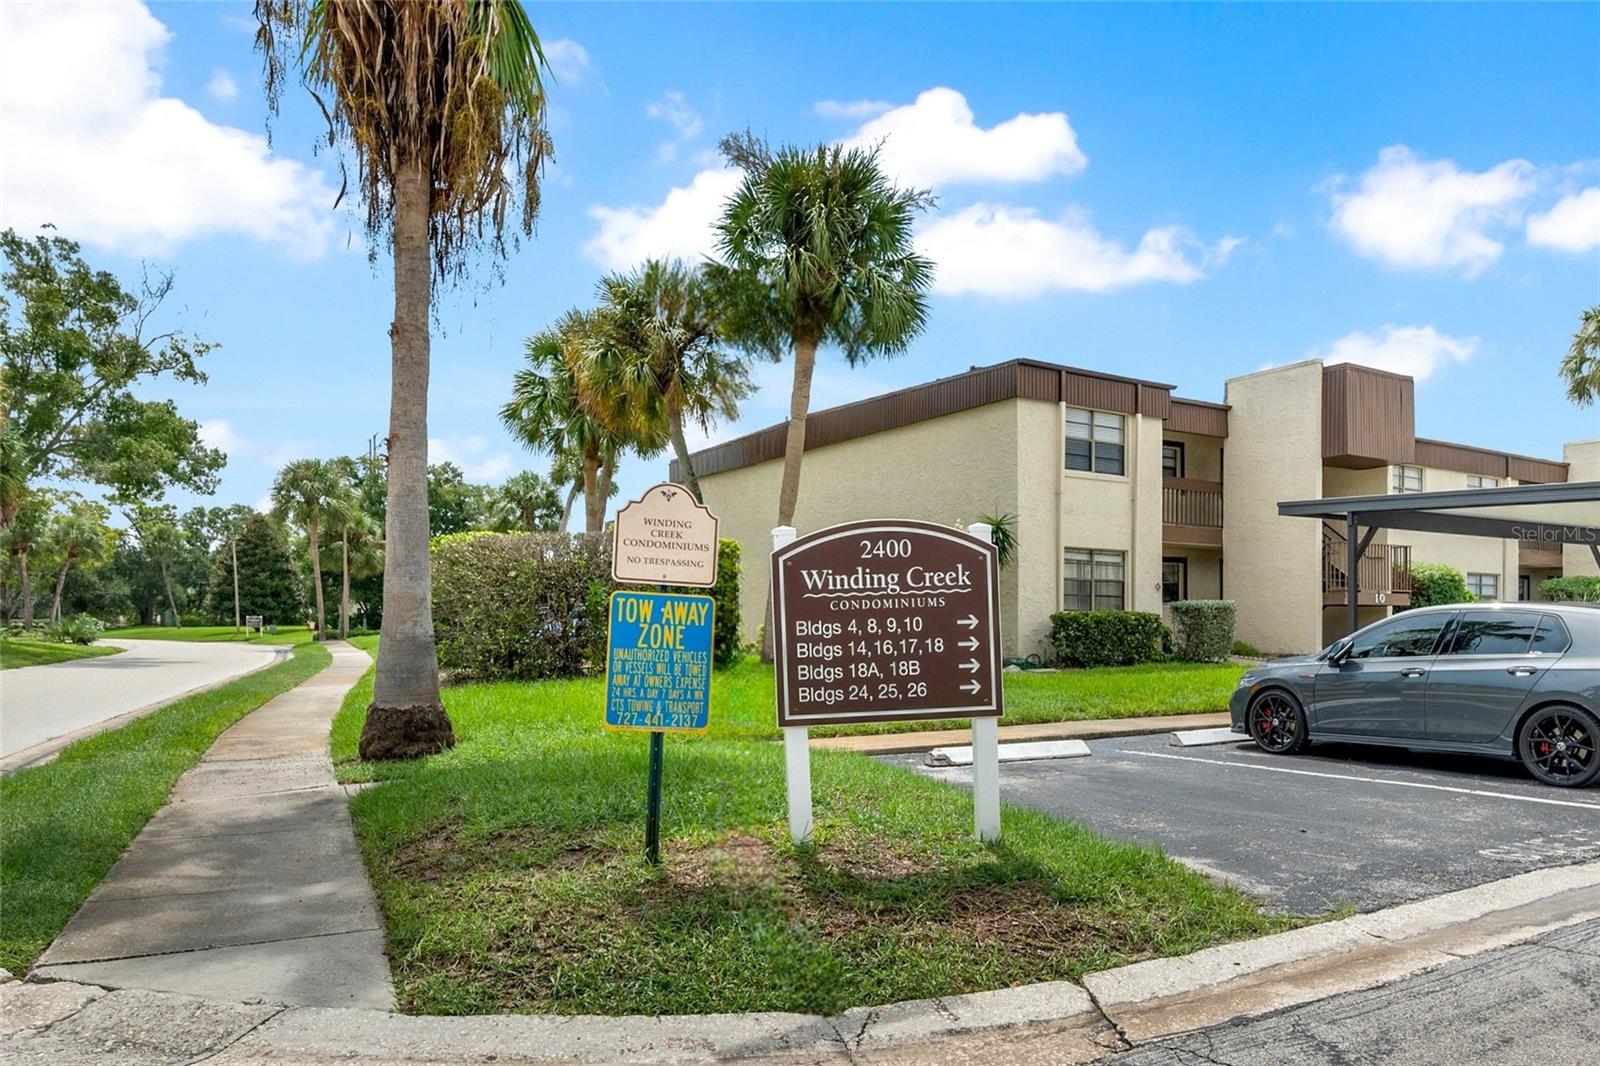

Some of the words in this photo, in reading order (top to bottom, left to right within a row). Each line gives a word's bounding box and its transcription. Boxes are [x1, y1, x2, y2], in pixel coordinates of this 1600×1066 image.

[643, 517, 692, 529] WINDING
[650, 529, 684, 539] CREEK
[623, 538, 710, 552] CONDOMINIUMS
[860, 538, 911, 558] 2400
[627, 556, 641, 564] NO
[643, 557, 704, 568] TRESPASSING
[800, 566, 900, 595] Winding
[906, 563, 972, 588] Creek
[830, 596, 946, 611] CONDOMINIUMS
[1375, 593, 1386, 604] 10
[617, 598, 654, 624] TOW
[662, 600, 709, 626] AWAY
[795, 620, 842, 639] Bldgs
[847, 618, 862, 636] 4,
[867, 618, 882, 635] 8,
[903, 616, 923, 632] 10
[637, 623, 686, 649] ZONE
[613, 648, 670, 662] UNAUTHORIZED
[672, 650, 708, 664] VEHICLES
[796, 642, 843, 661] Bldgs
[612, 660, 622, 673] OR
[625, 661, 654, 674] VESSELS
[656, 662, 670, 675] WILL
[673, 663, 682, 676] BE
[685, 664, 707, 677] TOWED
[797, 664, 844, 683] Bldgs
[849, 662, 884, 679] 18A,
[889, 660, 921, 676] 18B
[613, 674, 630, 686] AWAY
[633, 674, 641, 687] AT
[675, 676, 706, 690] EXPENSE
[798, 686, 845, 705] Bldgs
[848, 684, 873, 701] 24,
[878, 683, 903, 700] 25,
[907, 682, 927, 698] 26
[628, 699, 653, 713] TOWING
[665, 700, 704, 714] TRANSPORT
